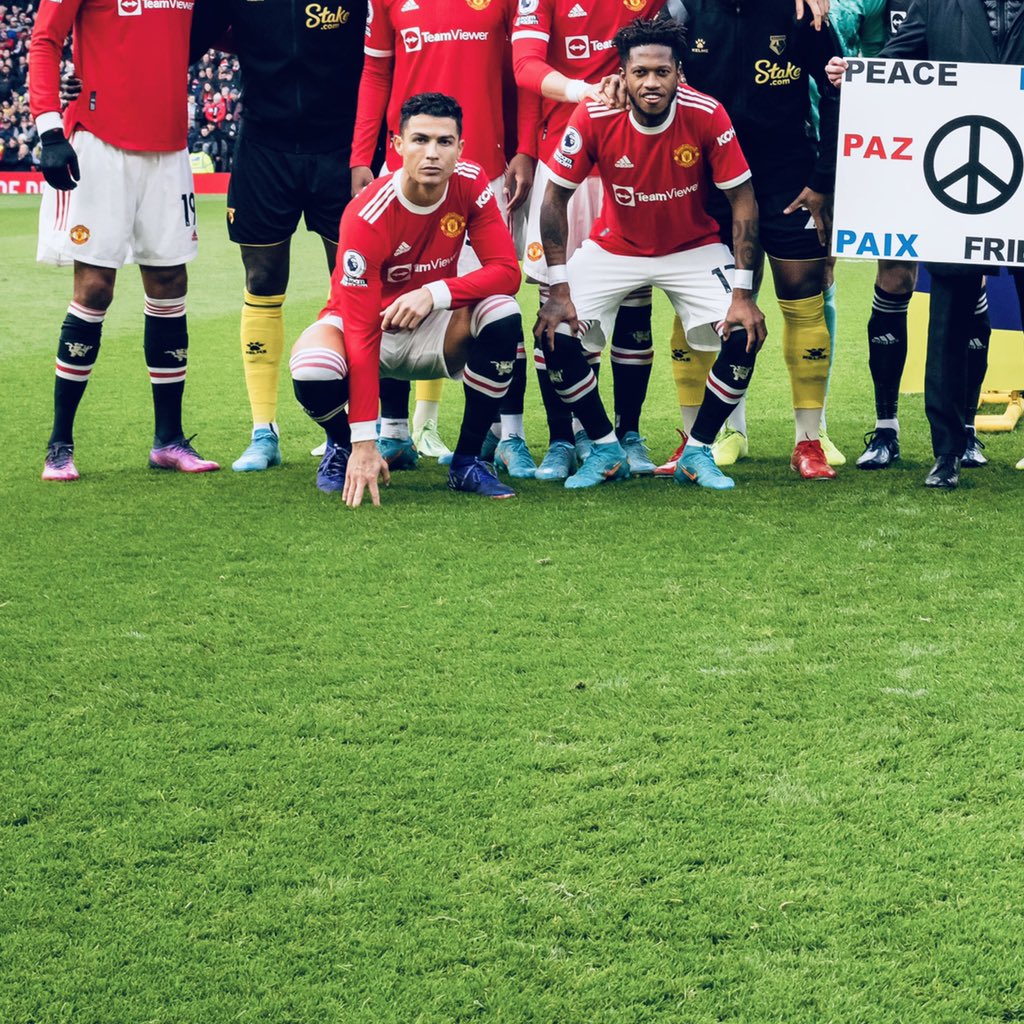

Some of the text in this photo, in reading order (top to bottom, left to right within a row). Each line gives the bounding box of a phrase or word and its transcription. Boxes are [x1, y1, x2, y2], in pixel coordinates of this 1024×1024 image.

[421, 28, 489, 43] TeamViewer
[755, 59, 802, 85] Stake
[770, 78, 791, 86] .com
[845, 60, 958, 86] PEACE
[843, 133, 914, 160] PAZ
[836, 229, 919, 258] PAIX
